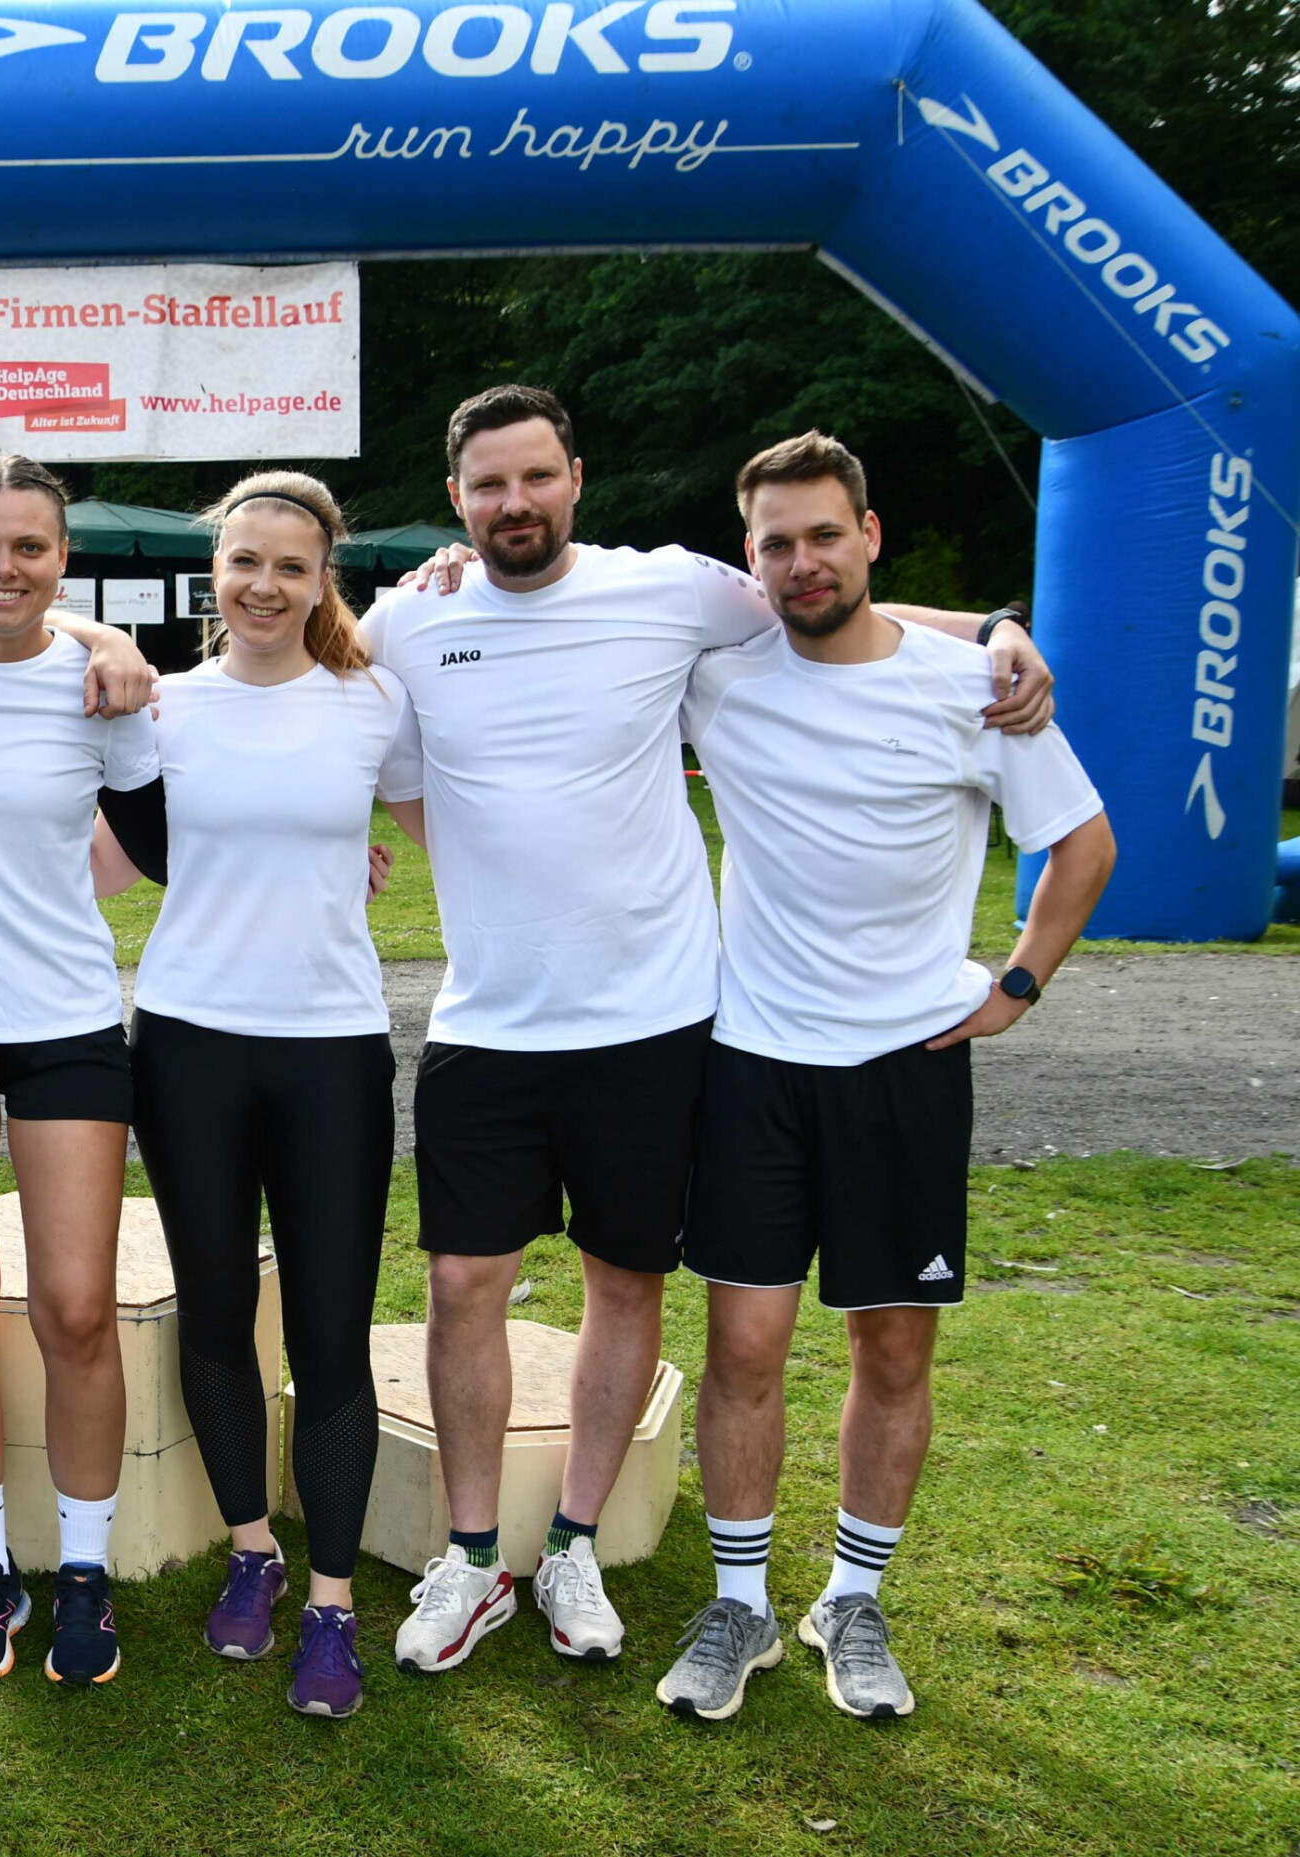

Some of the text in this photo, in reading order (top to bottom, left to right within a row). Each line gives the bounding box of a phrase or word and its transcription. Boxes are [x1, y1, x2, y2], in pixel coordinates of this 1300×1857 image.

[94, 0, 737, 83] BROOKS
[336, 107, 729, 172] run happy
[985, 147, 1232, 364] BROOKS
[30, 413, 121, 429] Alter ist Zukunft
[139, 390, 342, 417] www.helpage.de
[1191, 452, 1253, 748] BROOKS
[440, 649, 481, 667] JAKO
[918, 1269, 954, 1281] adidas
